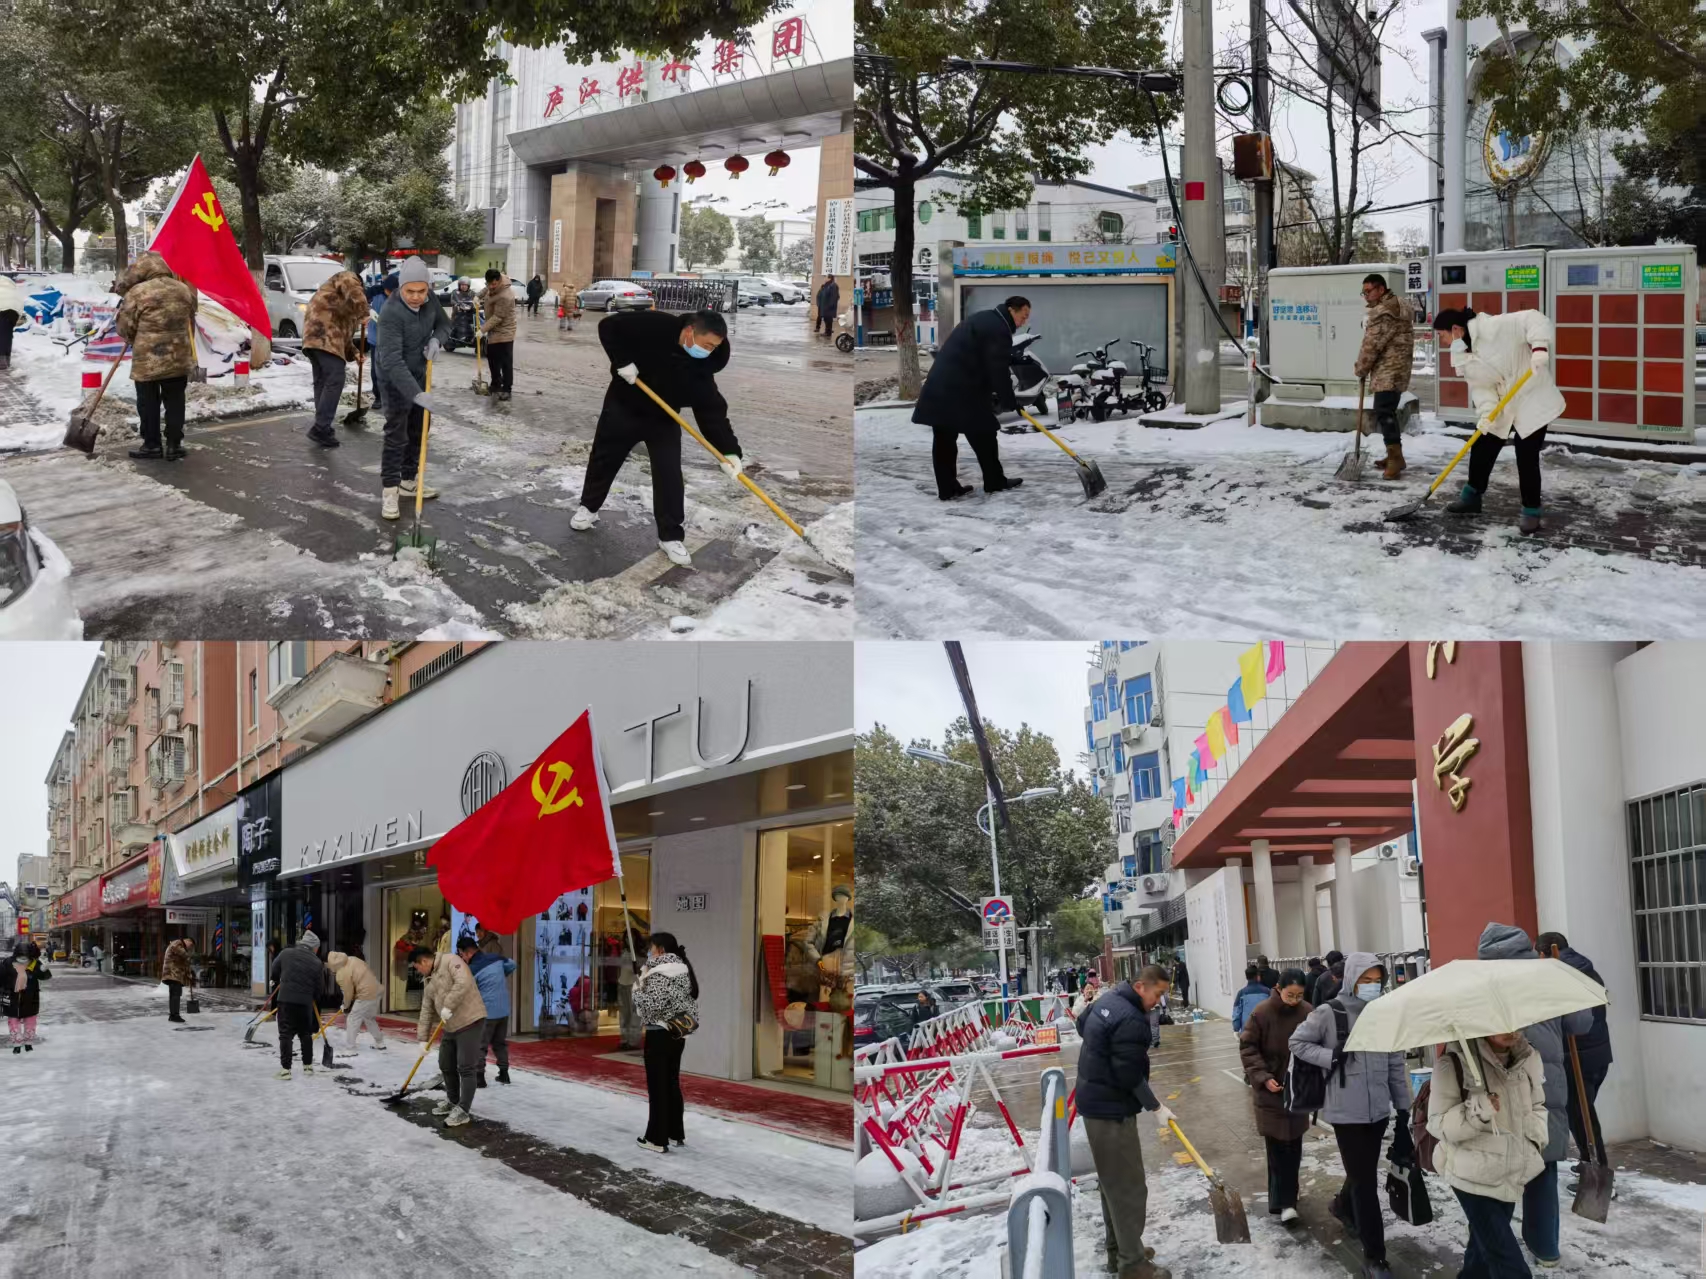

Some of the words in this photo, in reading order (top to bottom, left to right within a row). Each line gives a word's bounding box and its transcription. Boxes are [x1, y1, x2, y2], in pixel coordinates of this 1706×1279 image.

[544, 17, 803, 118] 庐江供水集团
[1408, 262, 1421, 290] 金箭
